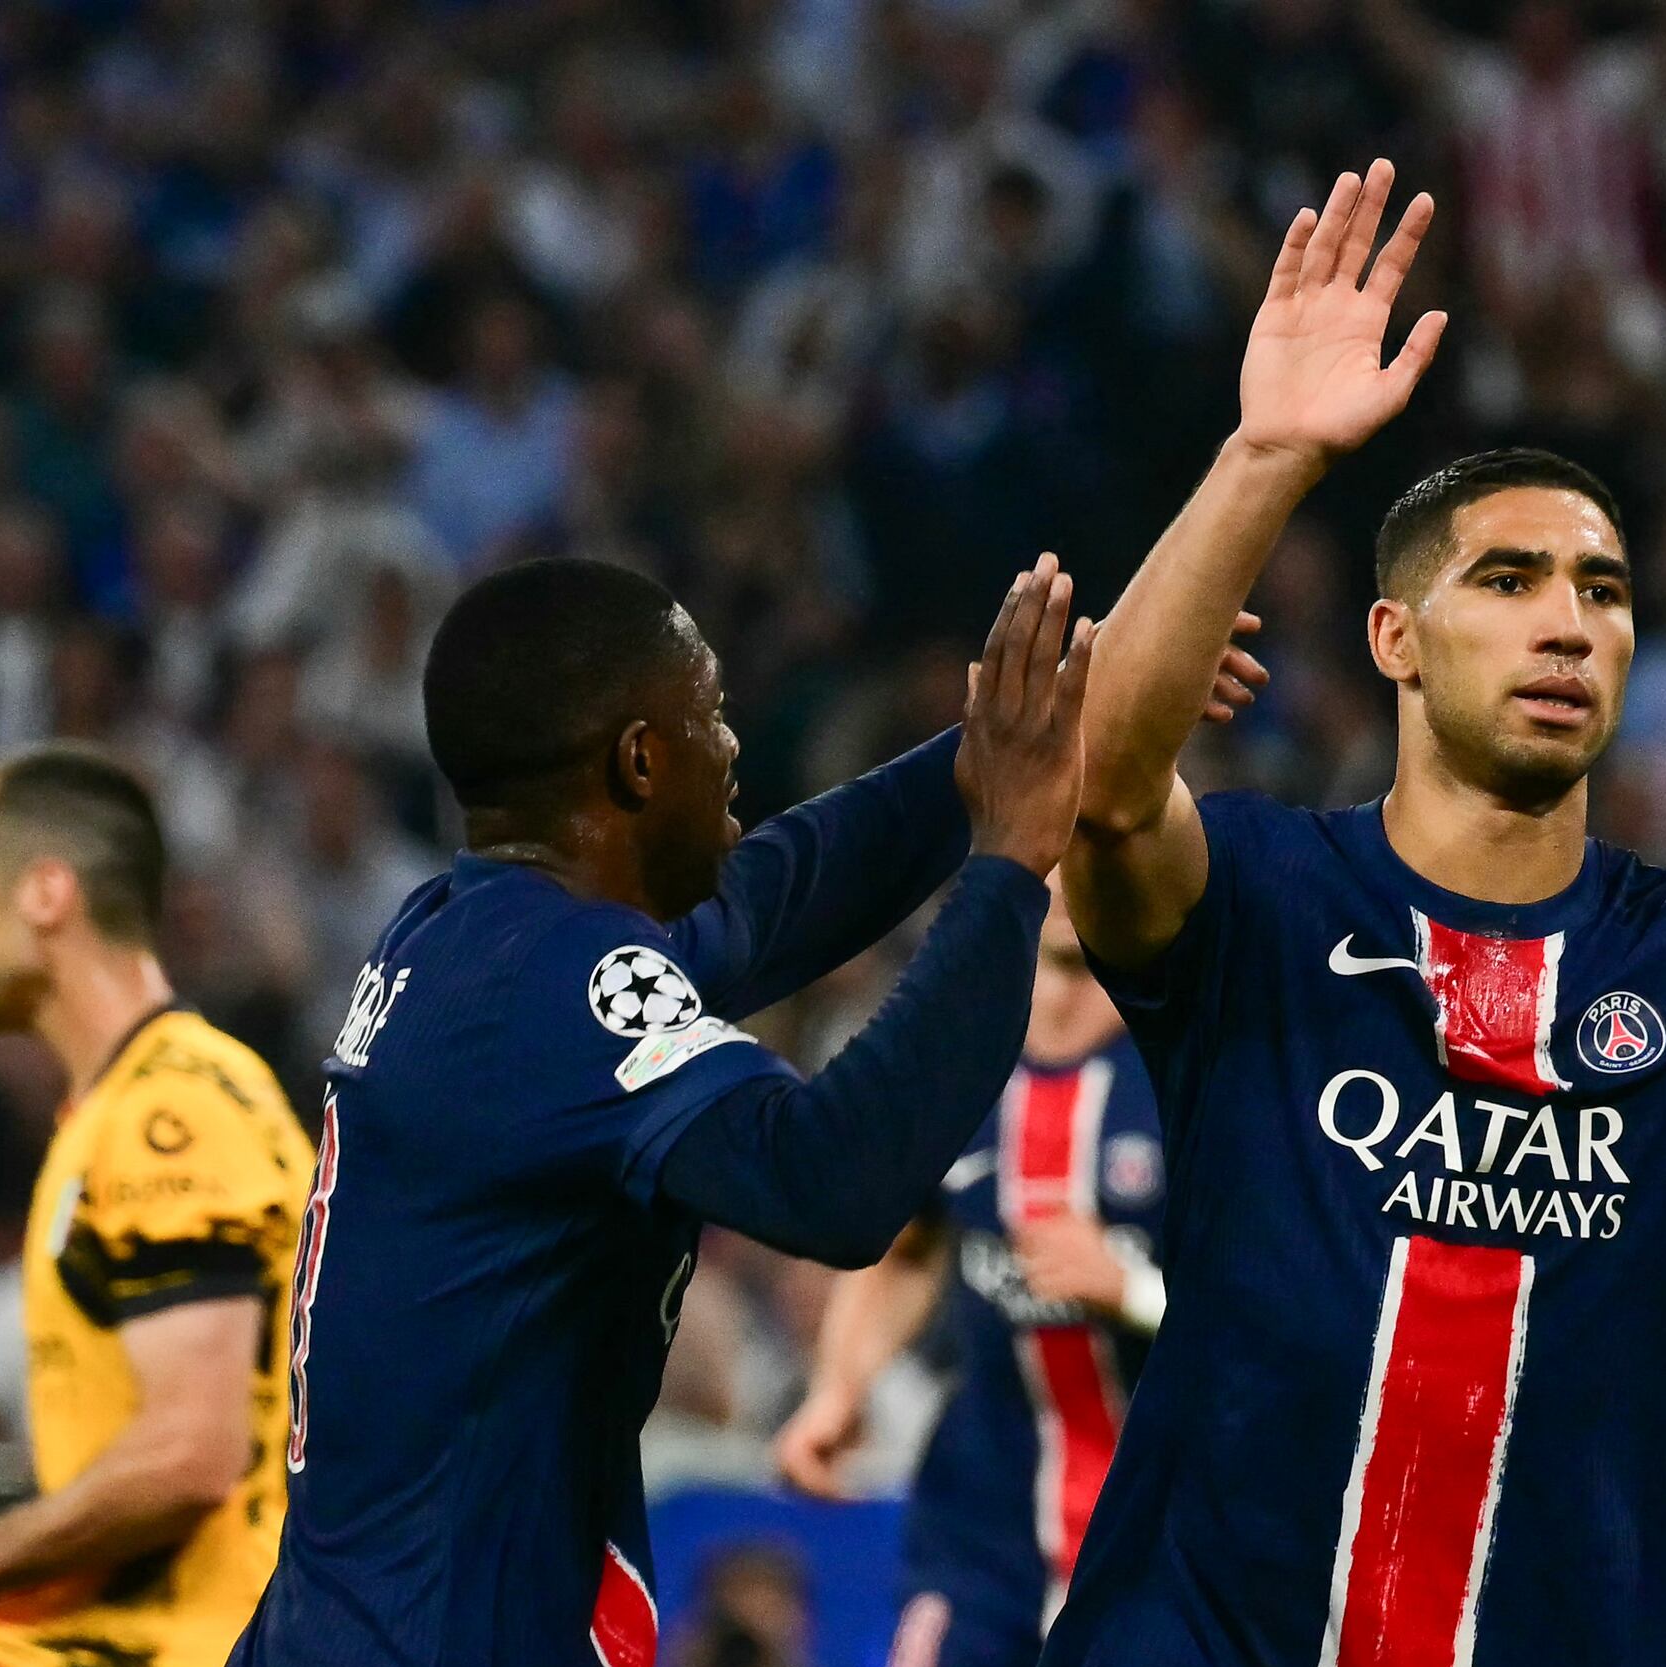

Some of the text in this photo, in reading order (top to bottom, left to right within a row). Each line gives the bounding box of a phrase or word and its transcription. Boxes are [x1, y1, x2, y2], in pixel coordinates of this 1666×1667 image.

[1588, 996, 1641, 1023] PARIS
[1317, 1069, 1631, 1184] QATAR
[1381, 1170, 1626, 1239] AIRWAYS
